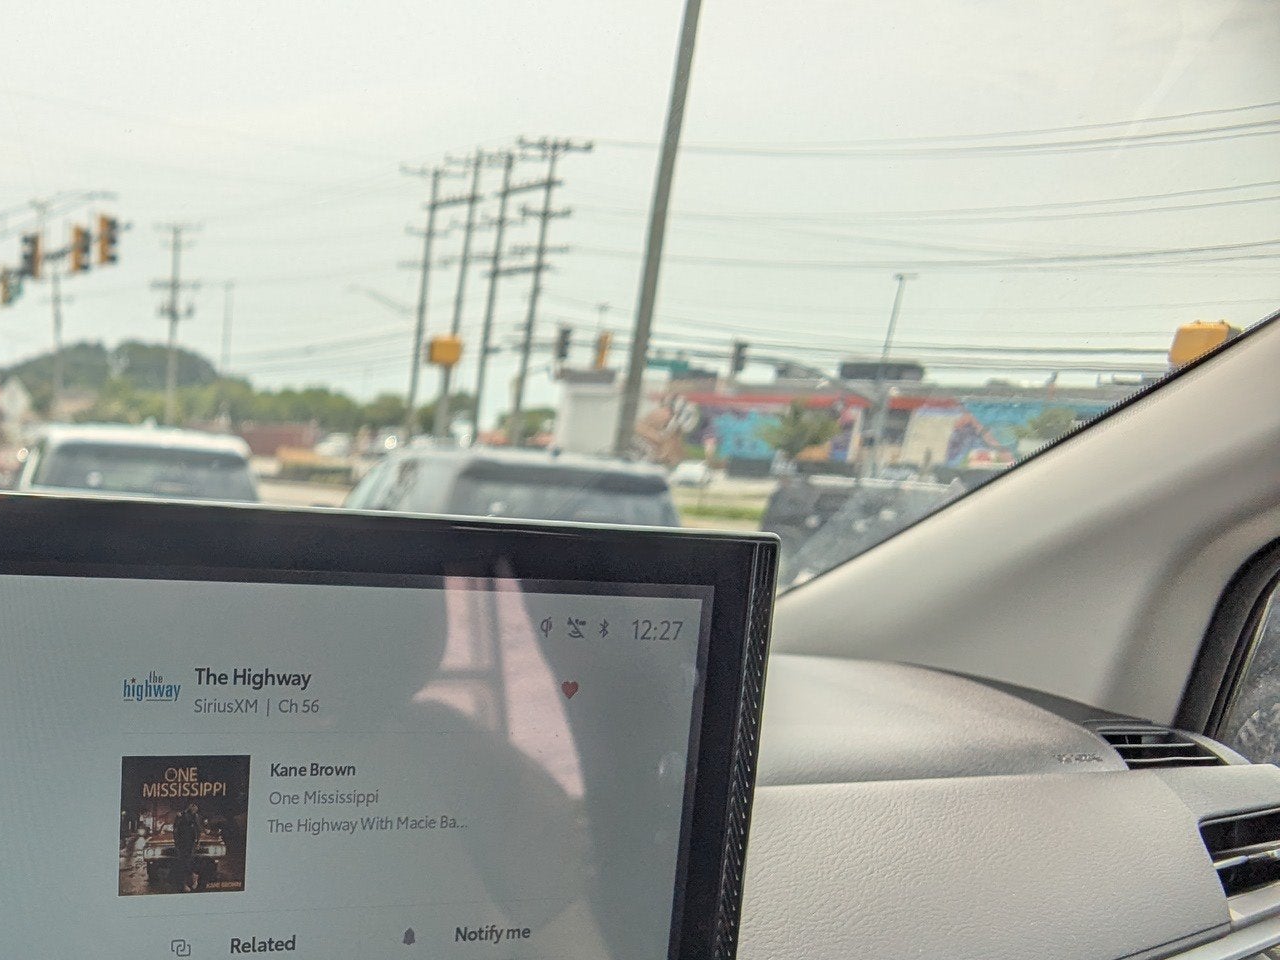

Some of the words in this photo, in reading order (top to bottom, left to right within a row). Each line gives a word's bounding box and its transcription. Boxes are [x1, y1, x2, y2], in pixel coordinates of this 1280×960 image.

[632, 619, 683, 641] 12:27
[149, 671, 163, 683] the
[195, 668, 228, 685] The
[233, 668, 311, 690] Highway
[123, 677, 181, 701] highway
[194, 699, 258, 713] SiriusXM
[278, 699, 298, 713] Ch
[303, 699, 320, 713] 56
[165, 767, 198, 782] ONE
[270, 763, 307, 777] Kane
[310, 763, 356, 777] Brown
[142, 782, 227, 798] MISSISSIPPI
[269, 791, 300, 805] One
[304, 790, 379, 807] Mississippi
[267, 819, 292, 833] The
[297, 818, 358, 835] Highway
[360, 817, 393, 831] With
[396, 816, 436, 830] Macie
[455, 925, 503, 944] Notify
[507, 927, 531, 940] me
[230, 935, 297, 954] Related
